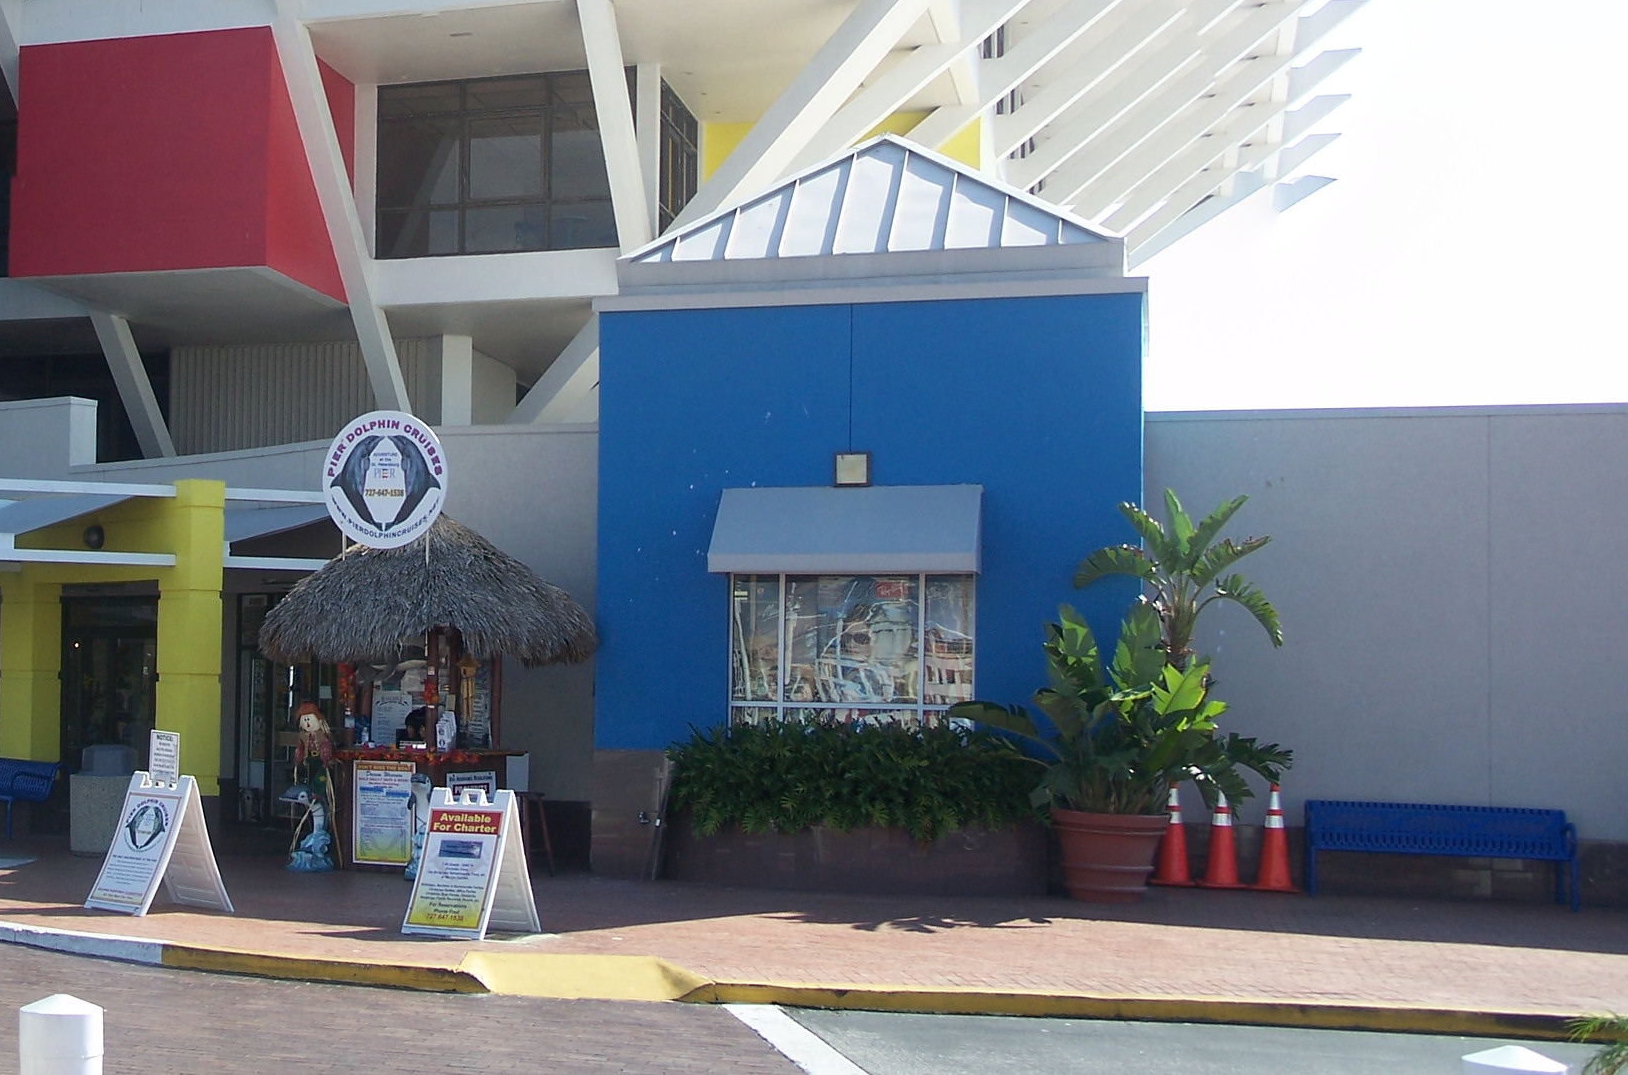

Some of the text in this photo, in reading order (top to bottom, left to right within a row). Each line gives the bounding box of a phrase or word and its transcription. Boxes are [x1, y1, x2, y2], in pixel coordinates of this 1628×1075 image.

[327, 419, 443, 477] PIER DOLPHIN CRUISES
[440, 812, 491, 823] Available
[433, 822, 497, 833] For Charter
